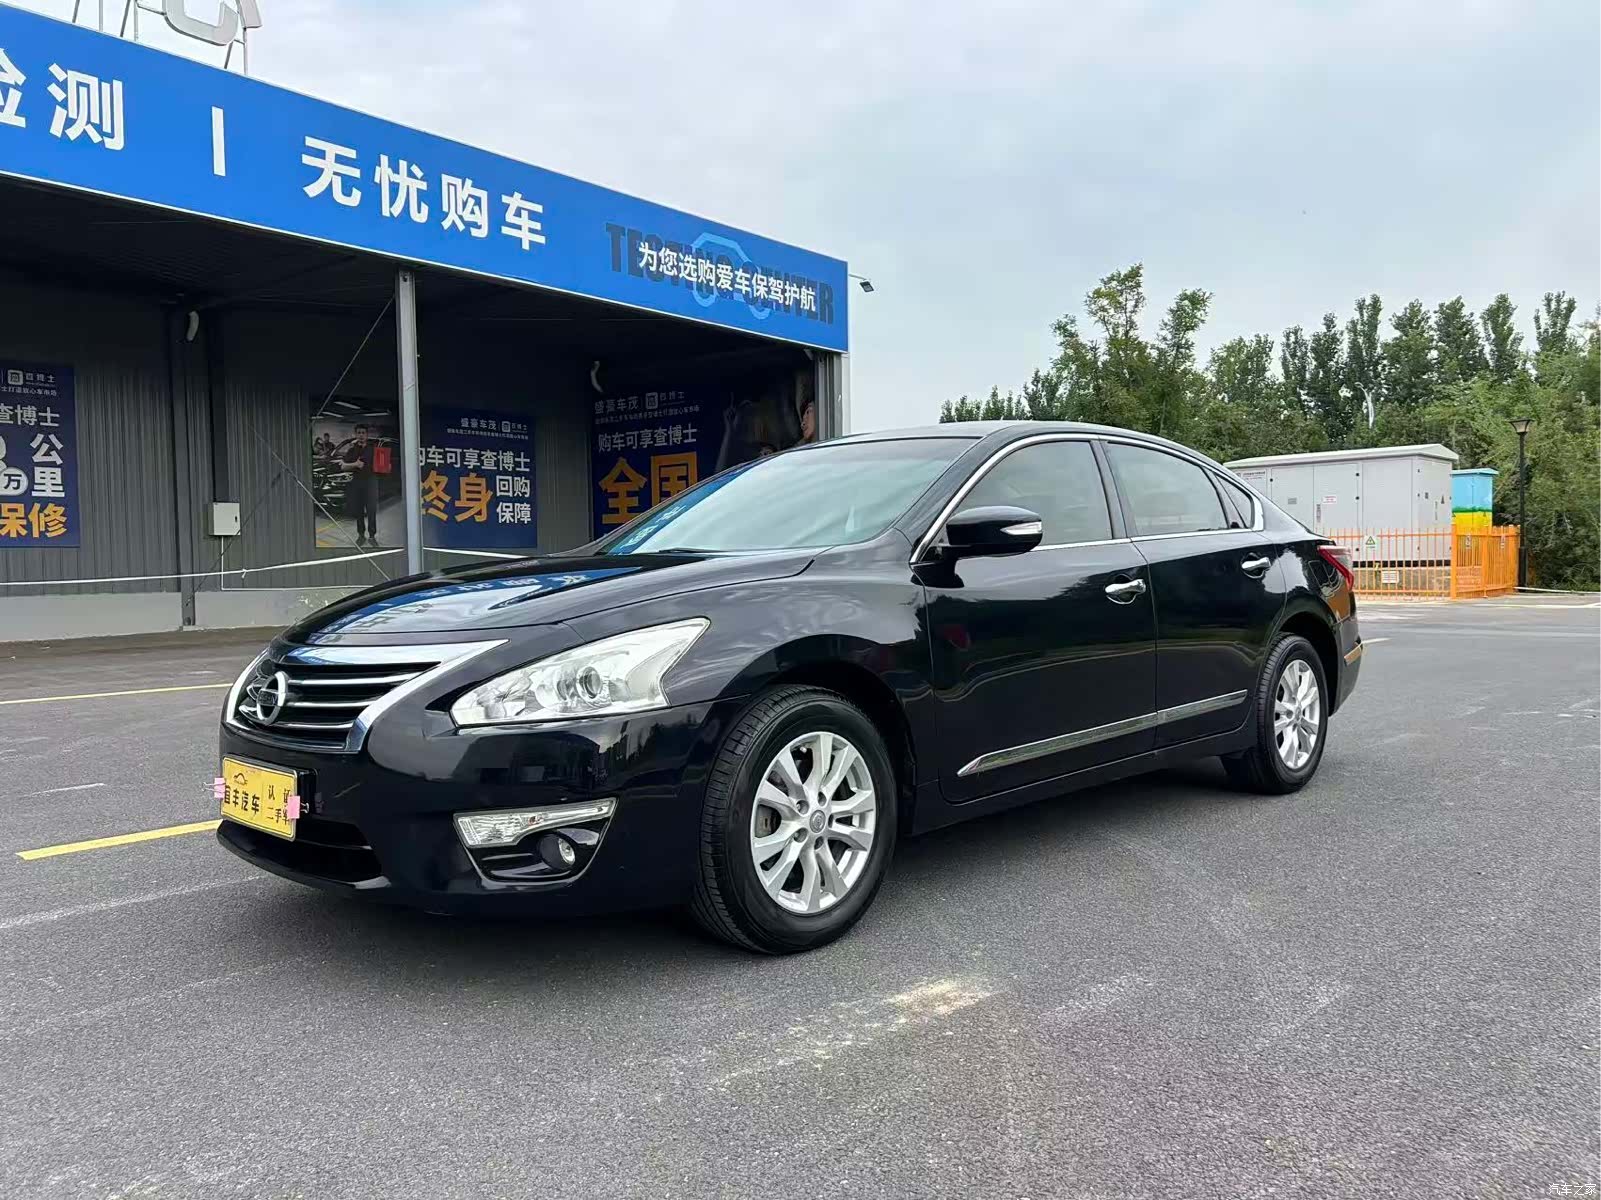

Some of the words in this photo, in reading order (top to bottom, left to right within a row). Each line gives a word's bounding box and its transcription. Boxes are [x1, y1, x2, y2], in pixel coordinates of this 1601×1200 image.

[301, 136, 547, 251] 无忧购车
[638, 242, 816, 312] 为您选购爱车保驾护航
[598, 423, 698, 453] 购车可享查博士
[4, 473, 22, 490] 万
[30, 433, 66, 498] 公里
[420, 470, 493, 523] 终身
[496, 475, 530, 499] 回购
[496, 501, 532, 524] 保障
